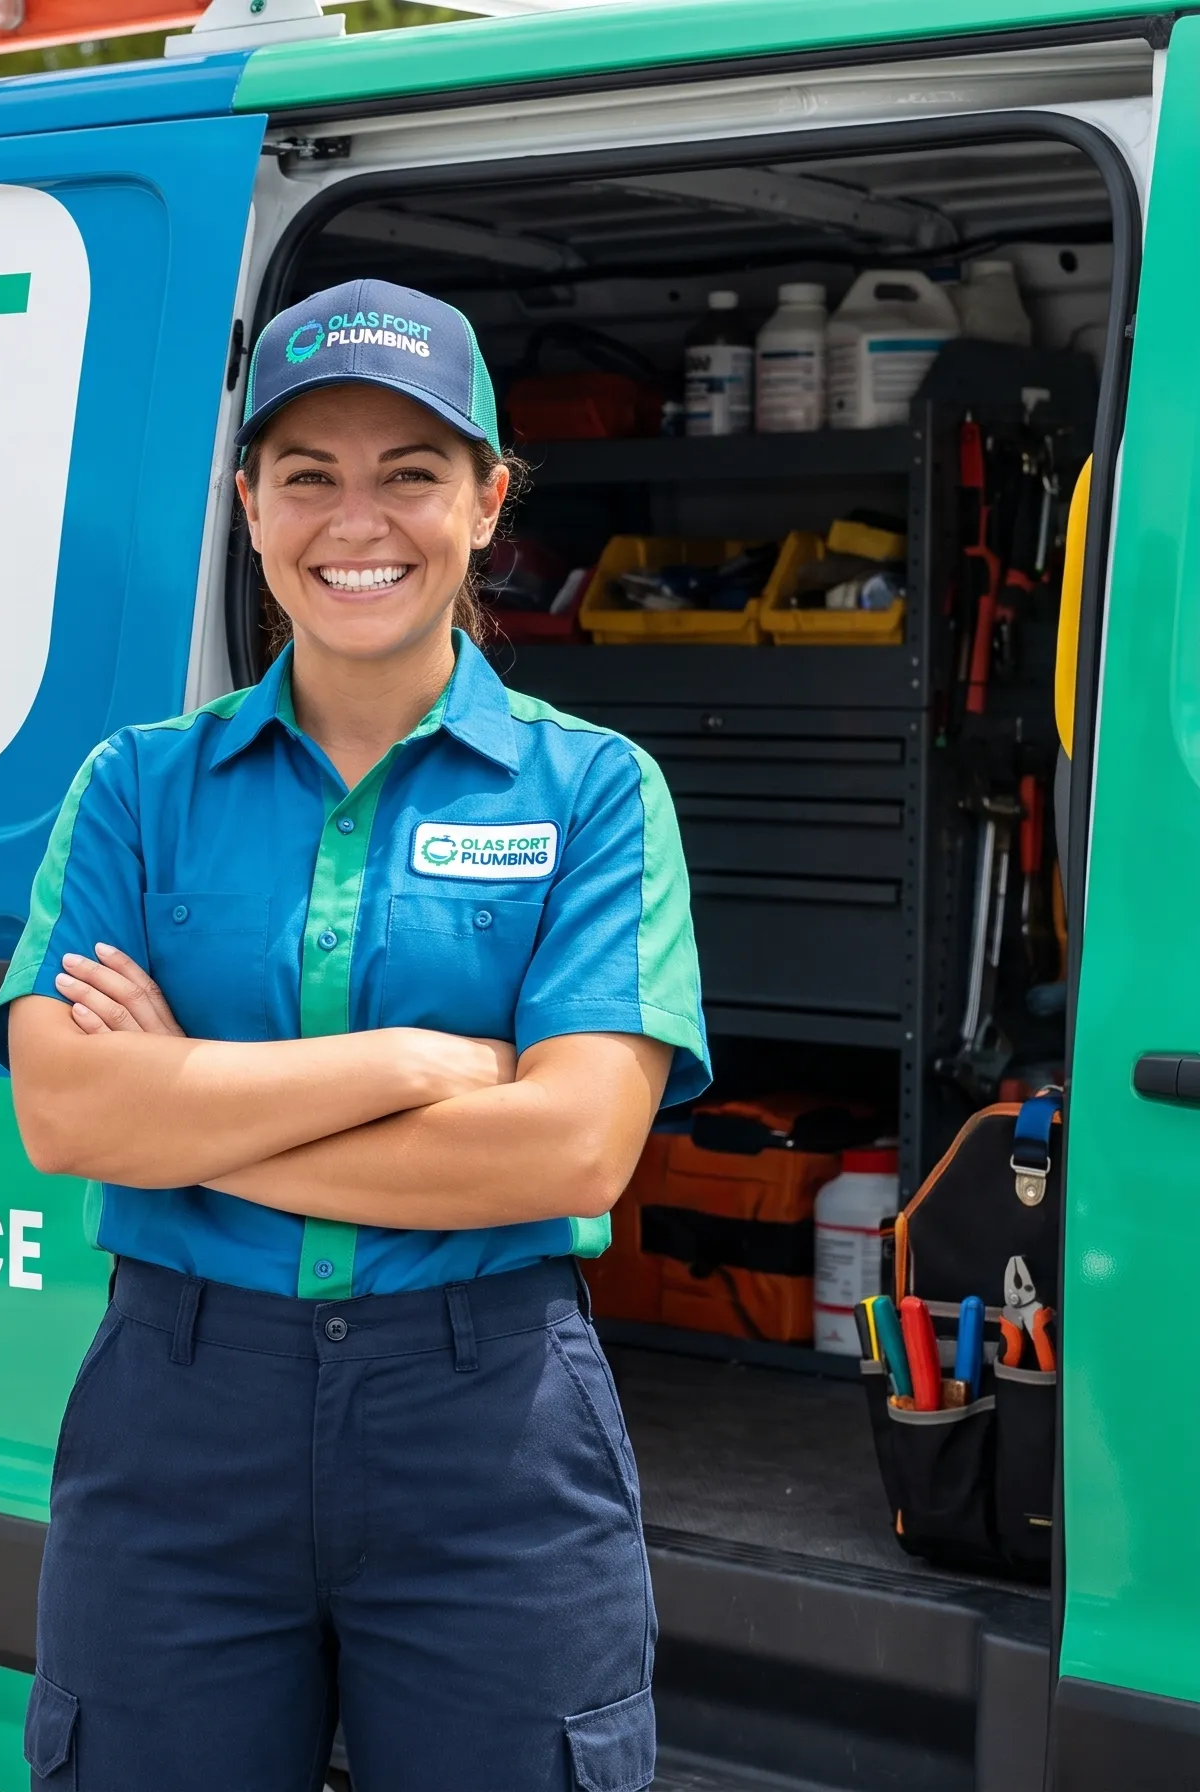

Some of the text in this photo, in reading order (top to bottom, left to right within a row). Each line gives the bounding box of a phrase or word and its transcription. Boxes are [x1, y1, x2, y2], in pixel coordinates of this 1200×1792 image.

[328, 311, 432, 341] OLAS FORT
[326, 328, 430, 357] PLUMBING
[461, 837, 550, 851] OLAS FORT
[461, 851, 548, 866] PLUMBING
